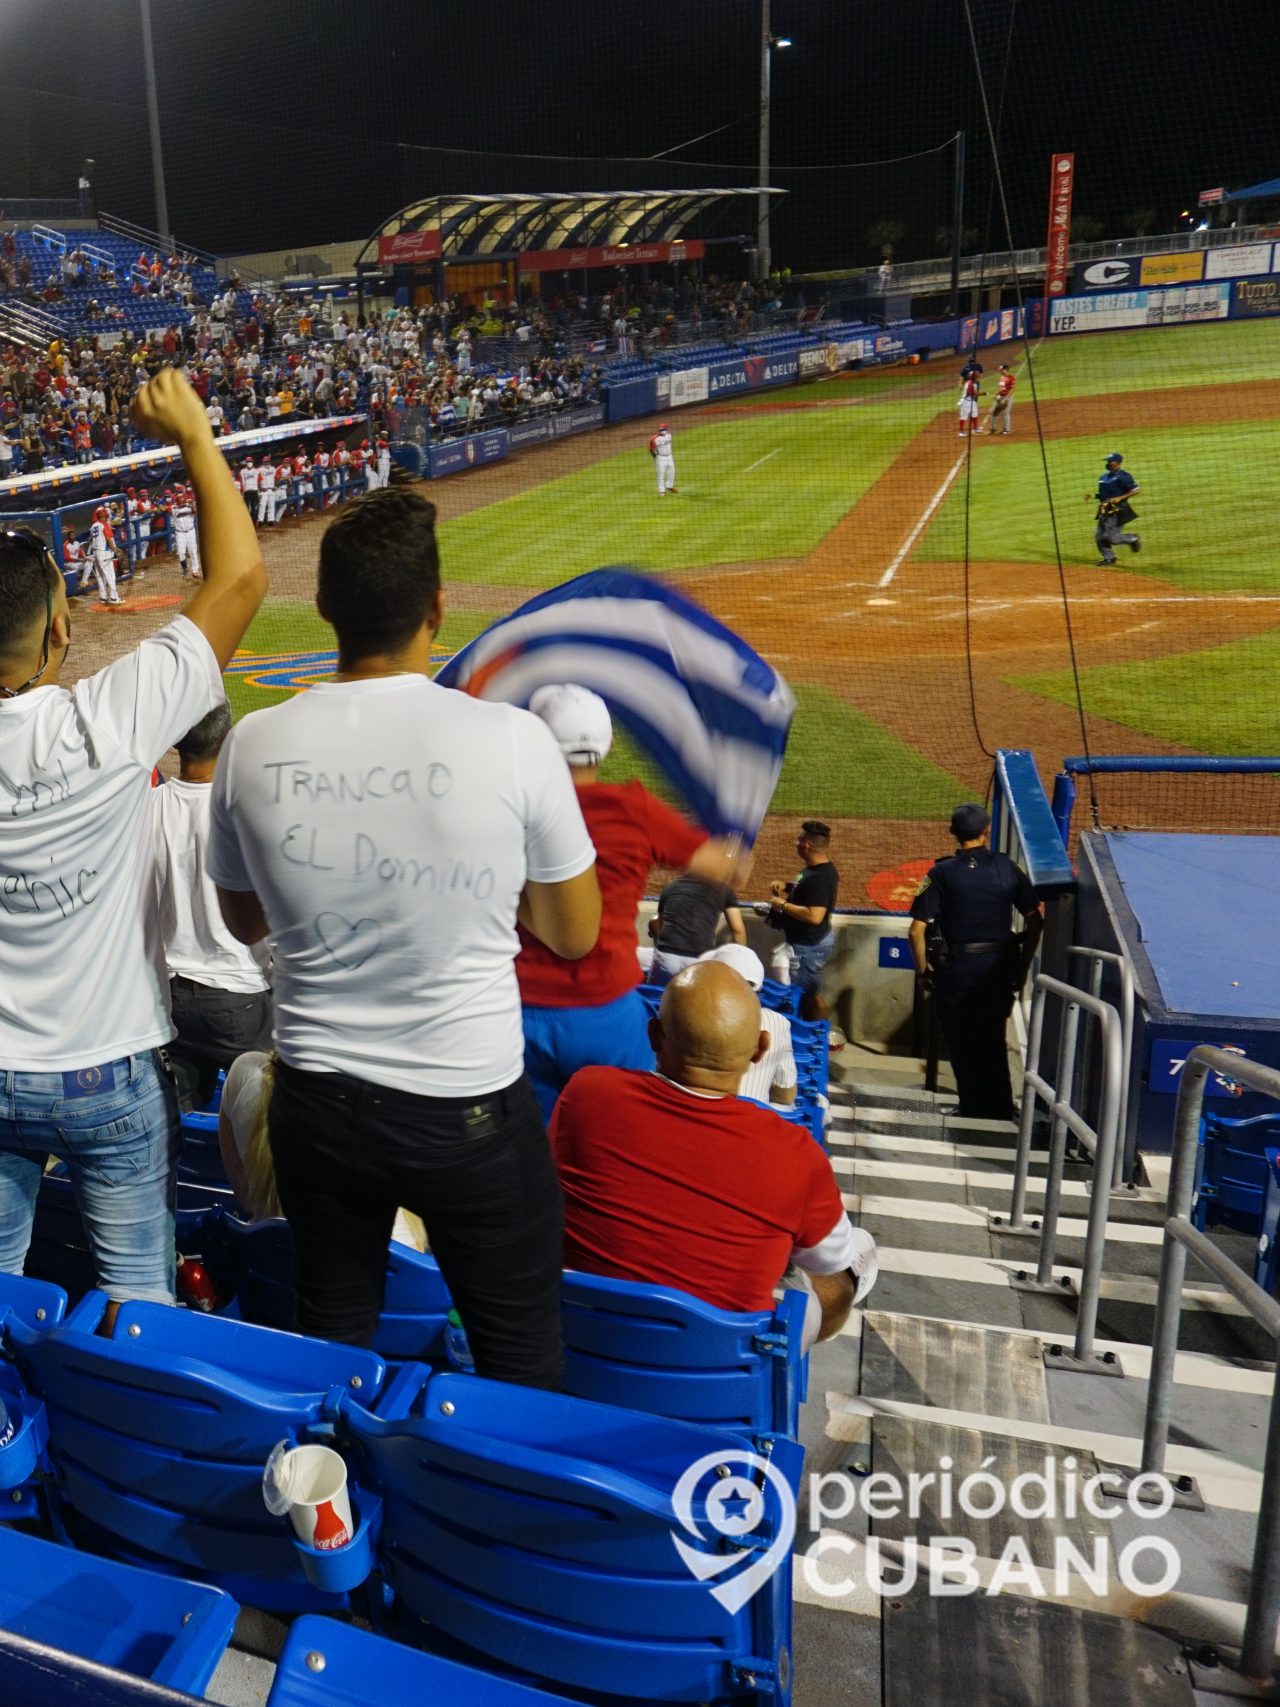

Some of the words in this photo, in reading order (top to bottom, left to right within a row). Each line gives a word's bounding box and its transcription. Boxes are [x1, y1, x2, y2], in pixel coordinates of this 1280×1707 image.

[603, 248, 635, 262] Budweiser
[635, 247, 659, 259] Terrace
[1055, 297, 1093, 315] TASTES
[1094, 293, 1138, 312] GREAT?
[1053, 316, 1076, 332] YEP.
[772, 362, 798, 378] DELTA
[718, 371, 747, 388] DELTA
[889, 947, 900, 959] 8
[1168, 1058, 1186, 1076] 7
